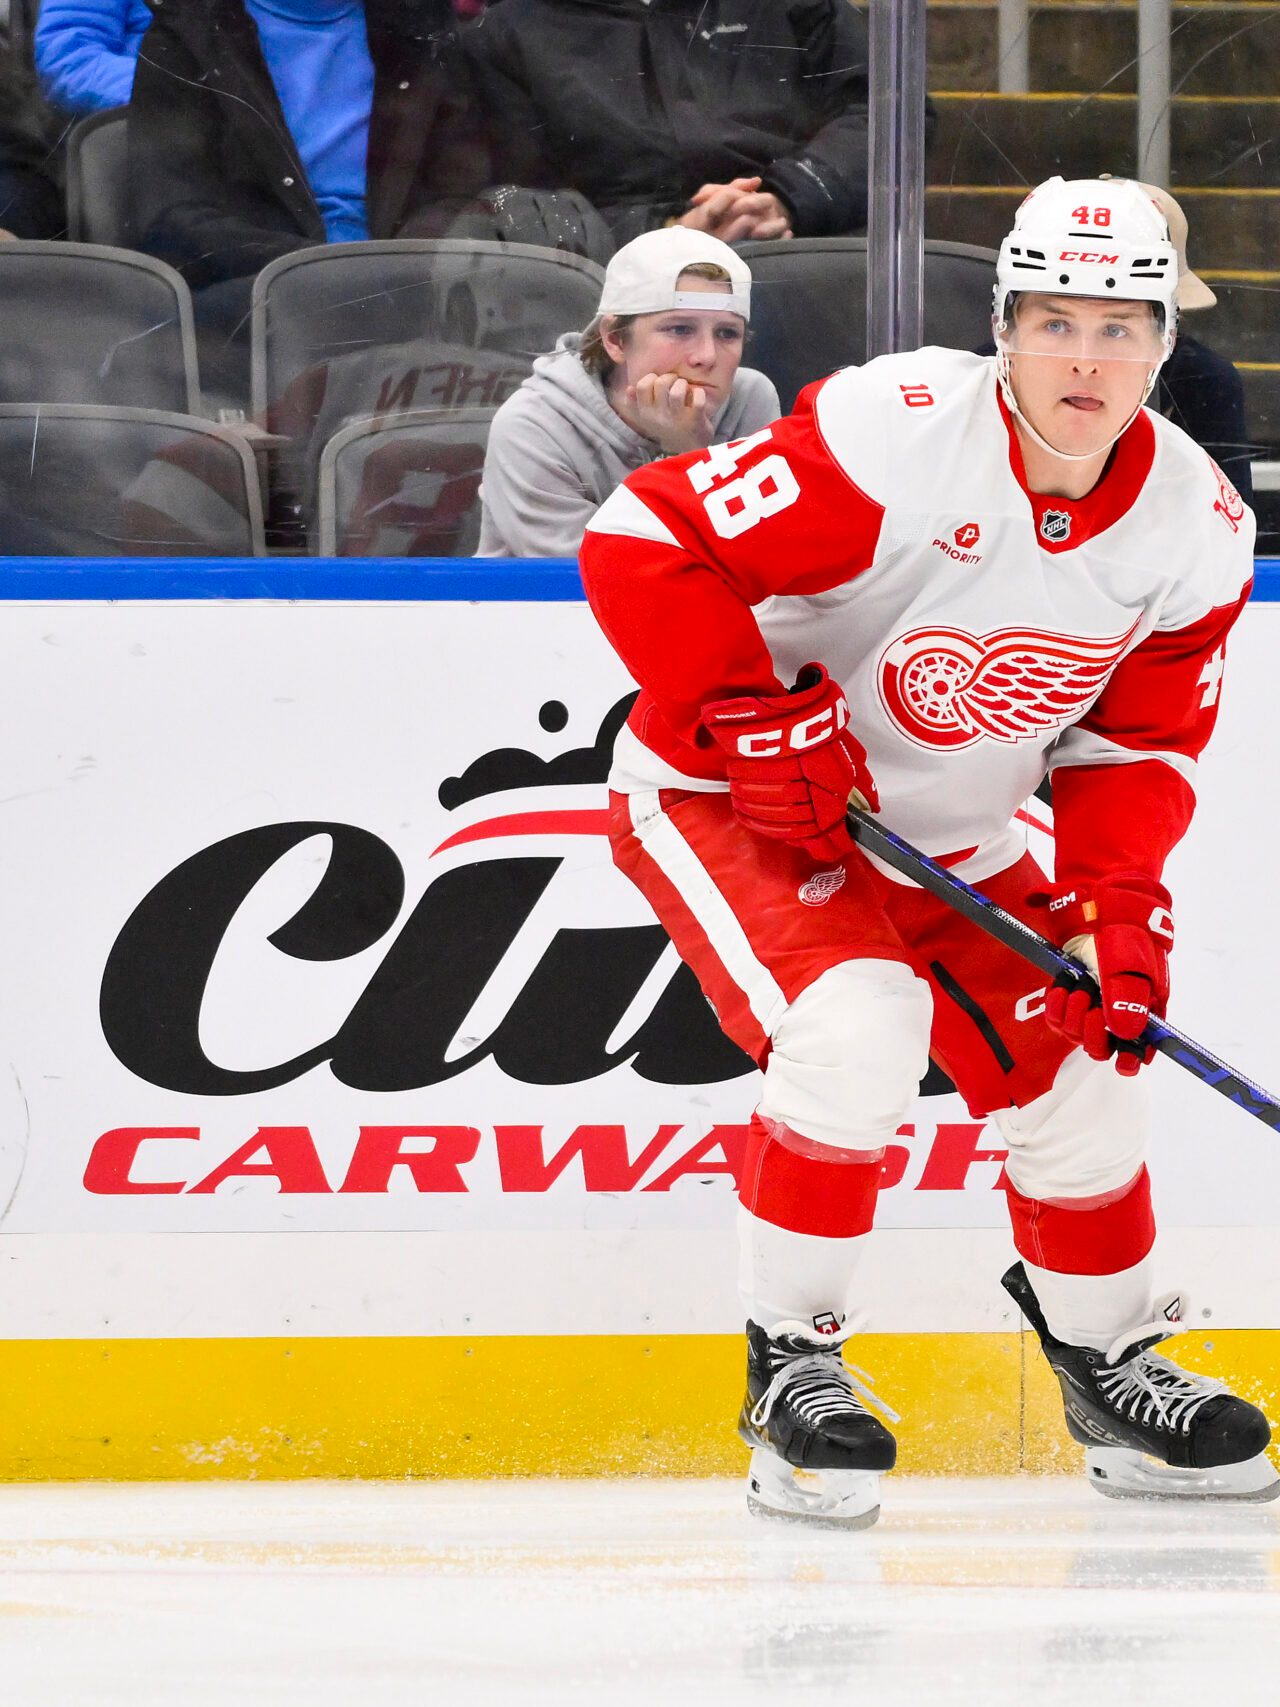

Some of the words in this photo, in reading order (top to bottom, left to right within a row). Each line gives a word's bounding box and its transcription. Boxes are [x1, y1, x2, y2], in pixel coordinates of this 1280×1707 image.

[1071, 206, 1112, 227] 48
[1059, 251, 1120, 265] CCM
[899, 383, 935, 408] 10
[686, 427, 801, 540] 48
[1045, 518, 1067, 535] NHL
[932, 538, 983, 565] PRIORITY
[1049, 891, 1077, 912] CCM
[100, 821, 957, 1097] Clu
